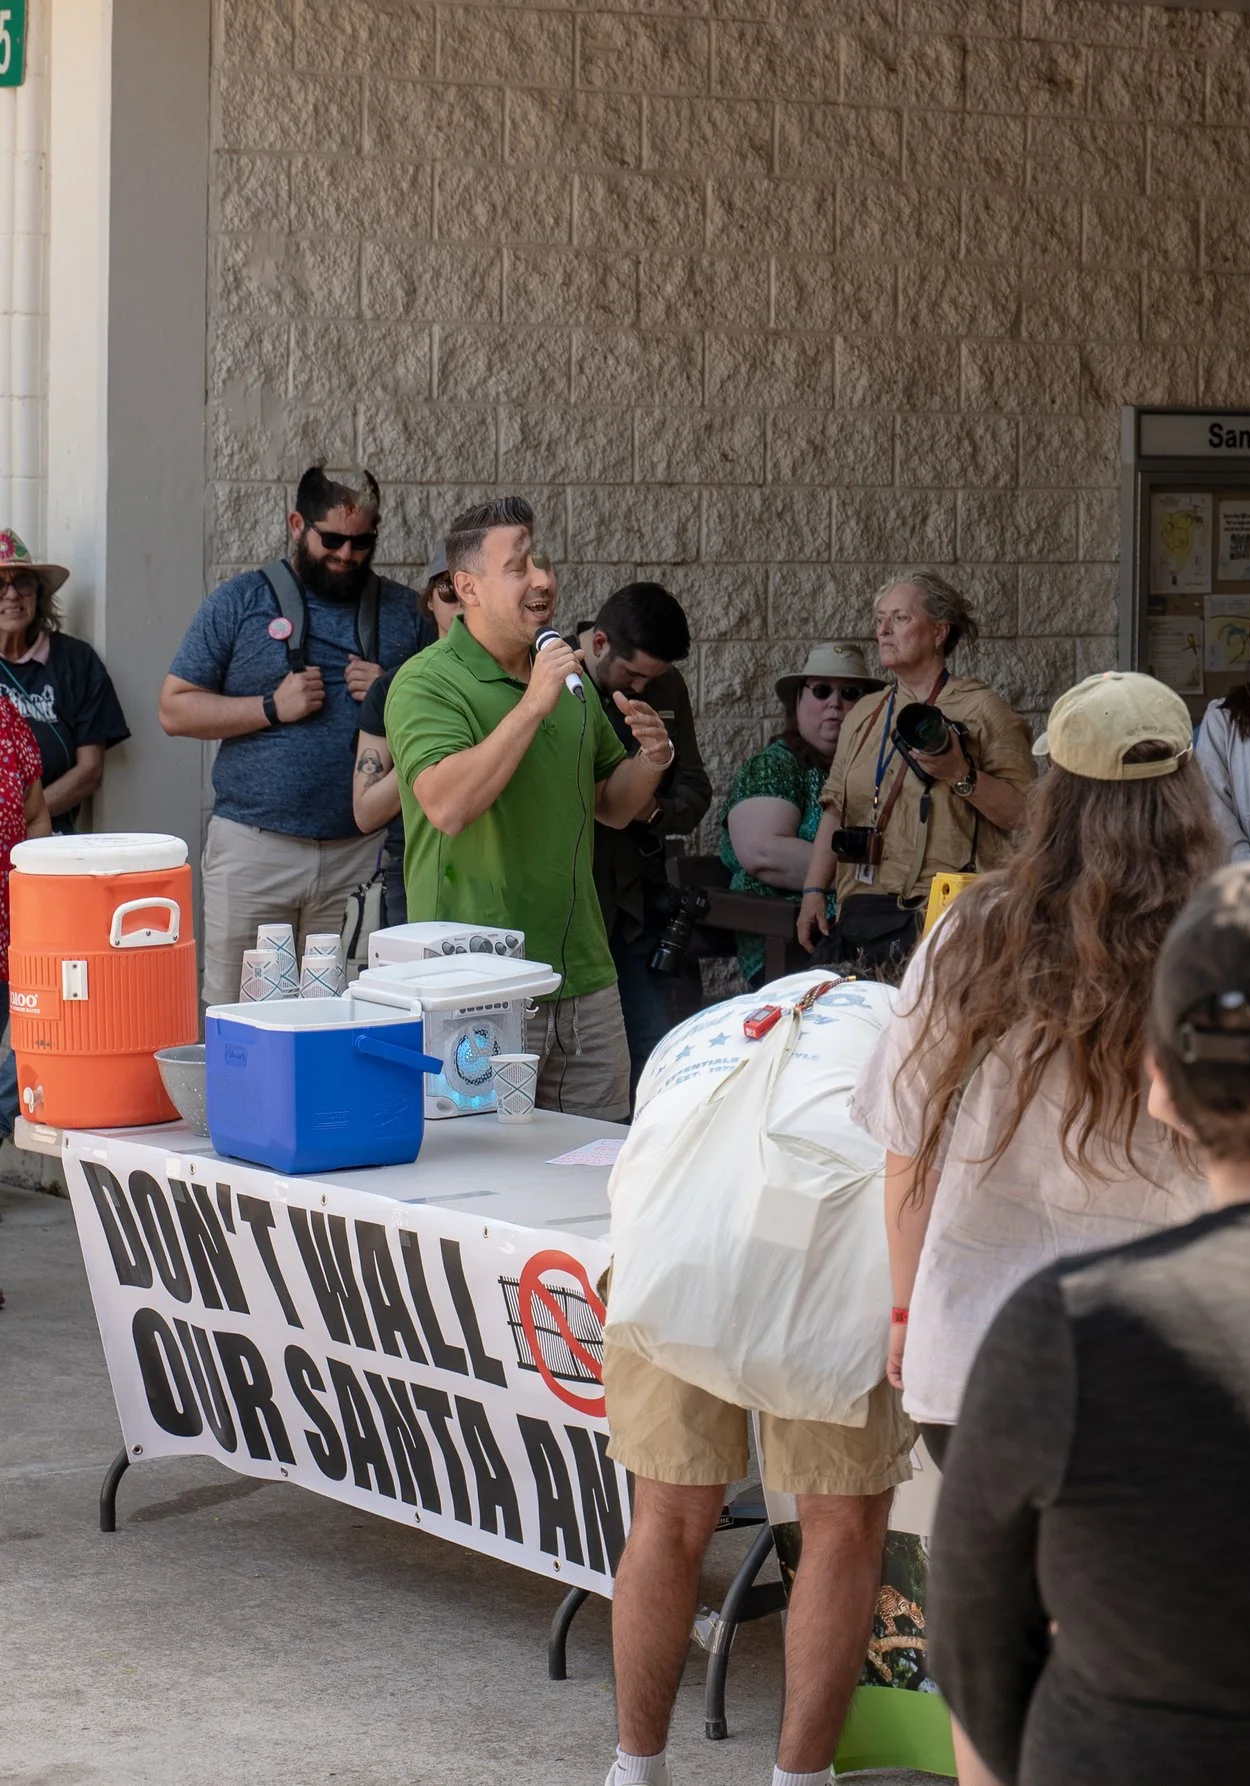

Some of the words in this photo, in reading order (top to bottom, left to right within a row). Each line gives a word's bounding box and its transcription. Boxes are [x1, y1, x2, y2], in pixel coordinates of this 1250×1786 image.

[80, 1160, 303, 1329] DON'T
[288, 1208, 508, 1388] WALL
[132, 1307, 296, 1466] OUR
[284, 1344, 523, 1544] SANTA
[516, 1413, 636, 1579] AN
